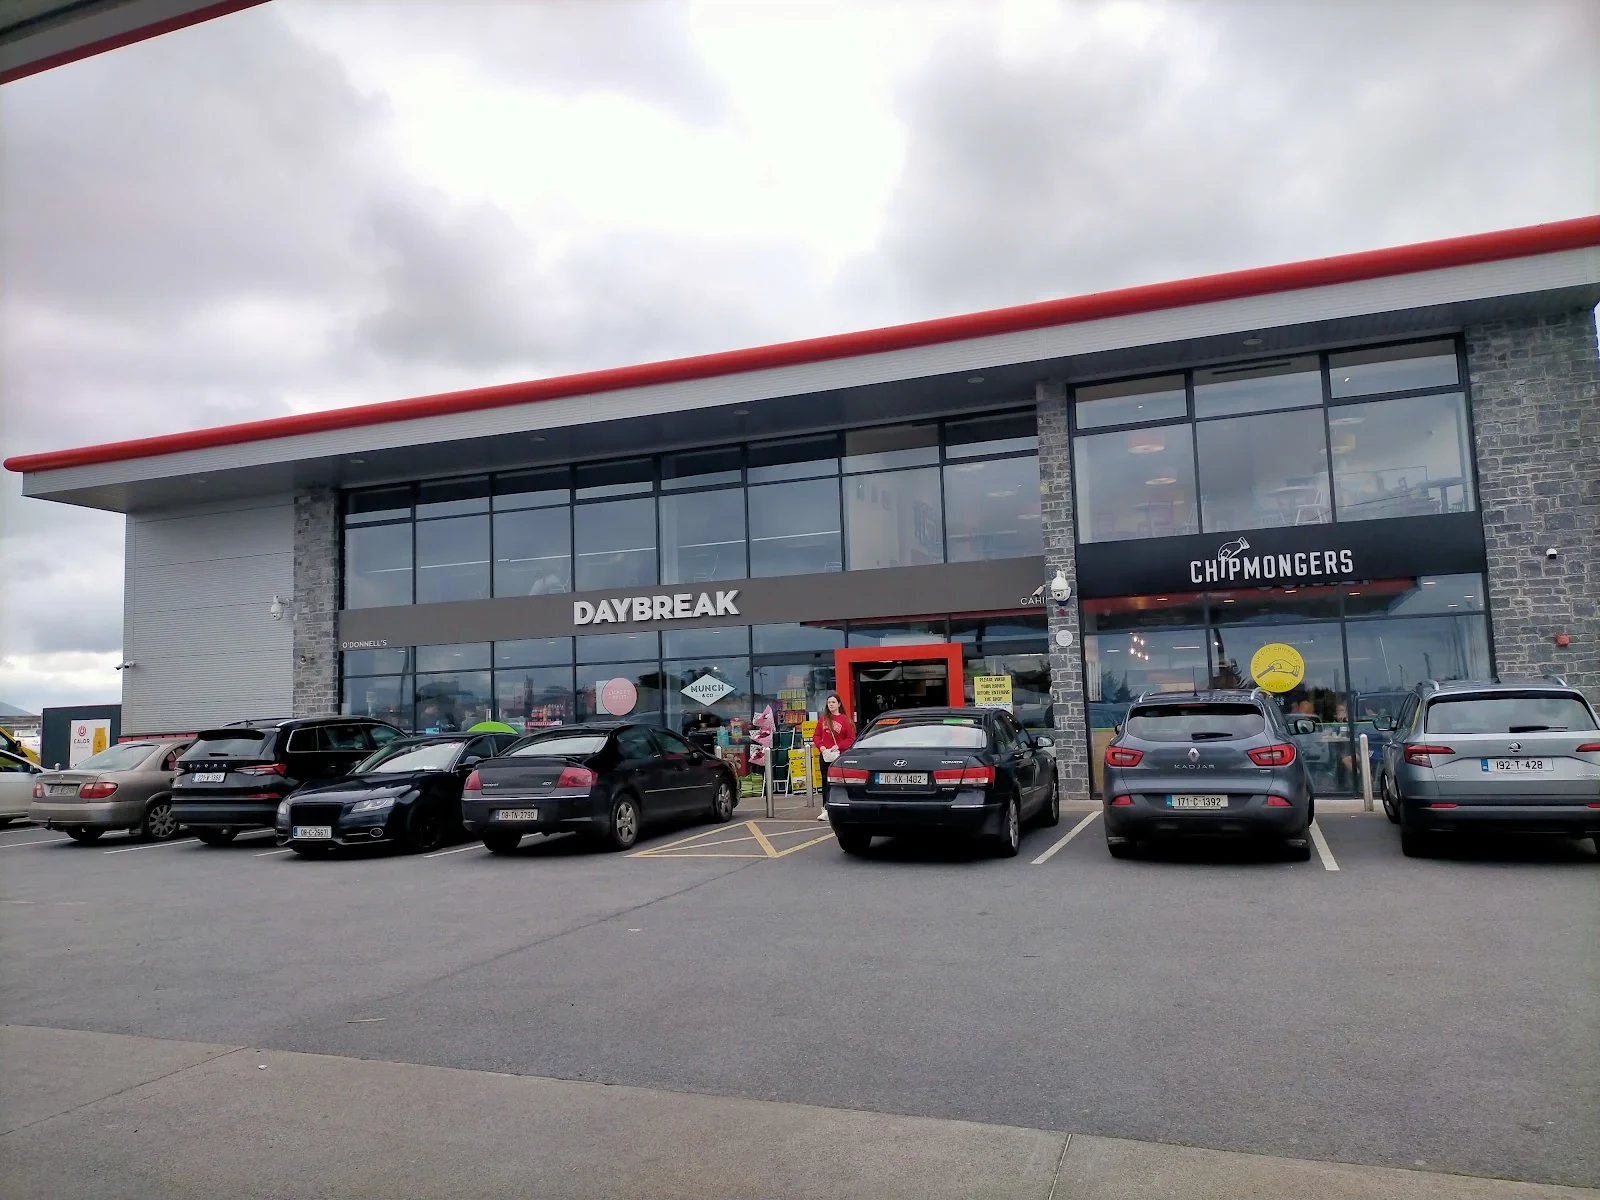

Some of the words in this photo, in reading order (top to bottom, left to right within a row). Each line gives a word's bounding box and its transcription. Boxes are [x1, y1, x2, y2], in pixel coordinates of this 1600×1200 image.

[1190, 550, 1354, 583] CHIPMONGERS
[1020, 595, 1047, 605] CAHI
[573, 590, 740, 625] DAYBREAK
[342, 640, 387, 648] O'DONNELL'S
[690, 684, 724, 692] MUNCH
[1496, 760, 1543, 770] 192-T-428
[884, 774, 923, 784] 10-KK-1482
[1177, 797, 1221, 806] 171-C-1392
[501, 811, 535, 819] 08-TN-2790
